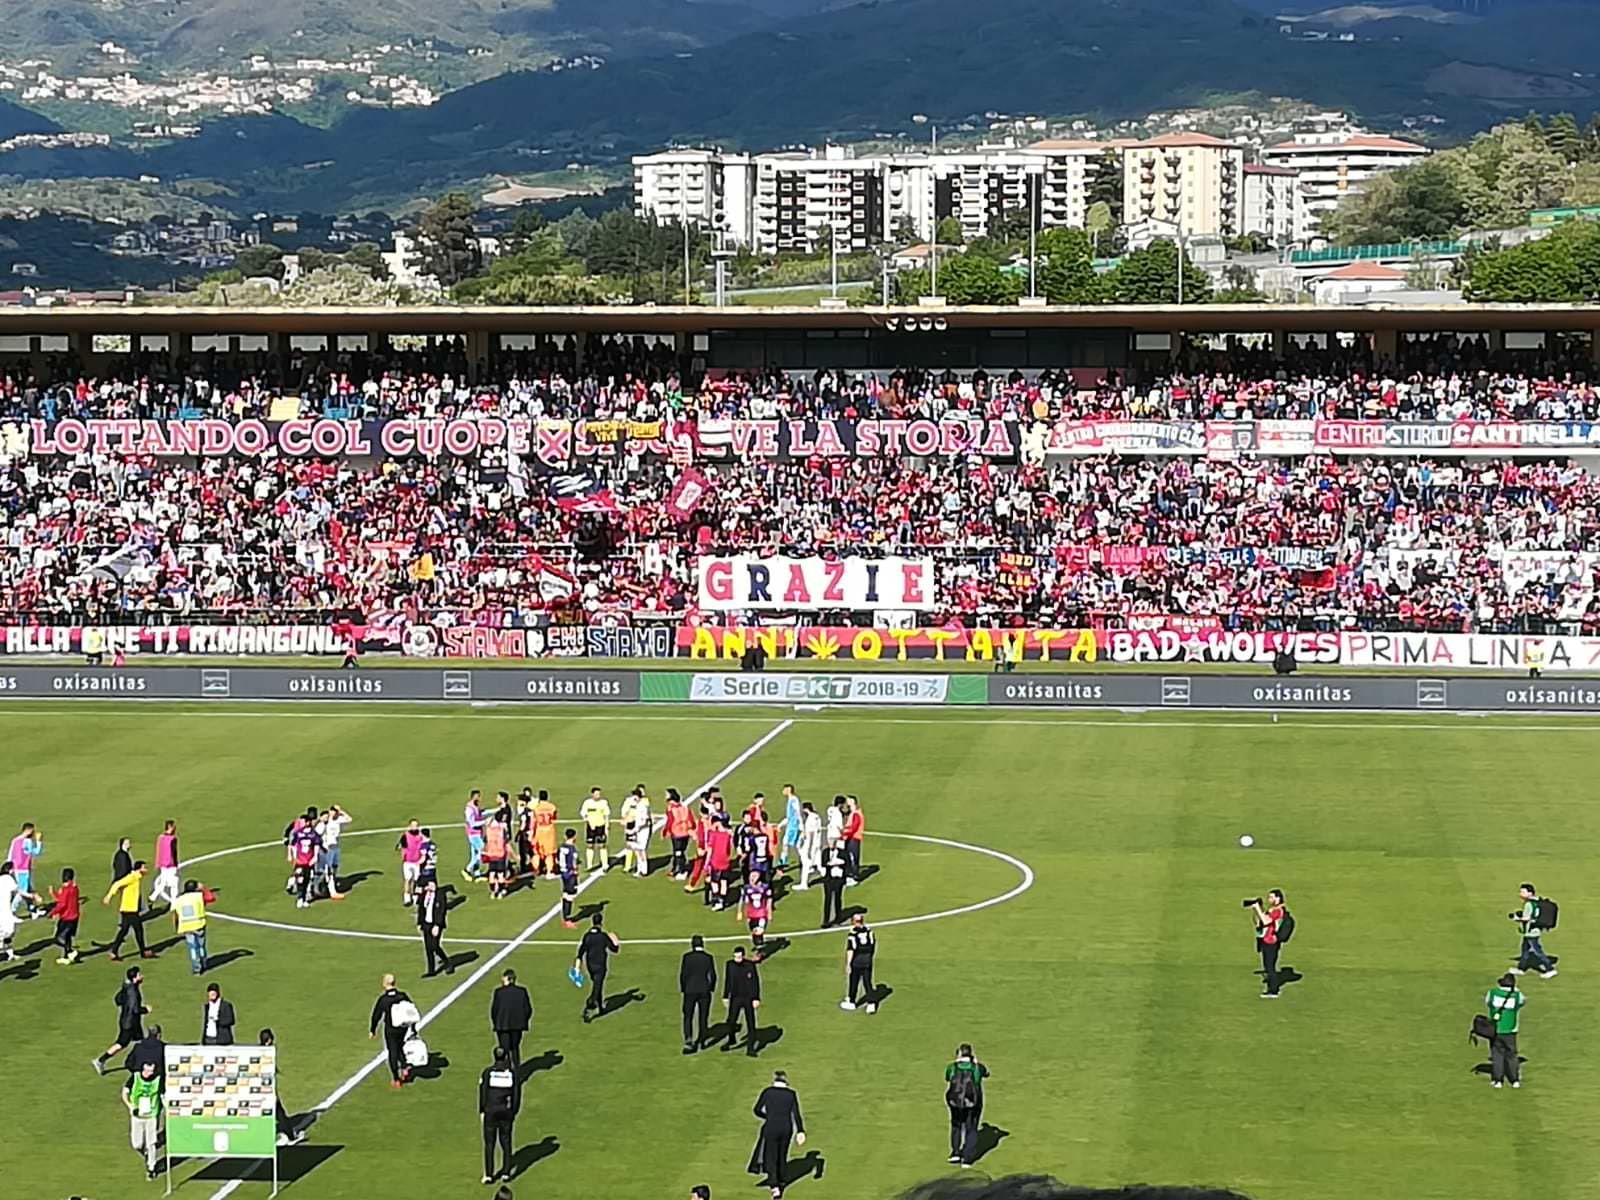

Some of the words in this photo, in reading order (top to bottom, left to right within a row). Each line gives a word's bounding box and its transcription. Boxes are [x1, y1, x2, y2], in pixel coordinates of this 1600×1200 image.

[30, 418, 269, 455] LOTTANDO
[279, 419, 371, 455] COL
[382, 418, 531, 455] CUORE
[789, 420, 850, 456] LA
[856, 419, 1015, 456] STORIA
[1317, 424, 1386, 444] CENTRO
[1453, 424, 1600, 444] CANTINELLA
[705, 561, 924, 603] GRAZIE
[6, 626, 70, 652] ALLA
[151, 626, 179, 653] TI
[189, 625, 343, 652] RIMANGONO
[691, 628, 795, 660] ANNI
[1112, 631, 1181, 662] BAD
[1208, 631, 1339, 662] WOLVES
[1348, 635, 1453, 664] PRIMA
[53, 673, 146, 690] oxisanitas
[289, 675, 382, 693] oxisanitas
[527, 677, 620, 694] oxisanitas
[723, 676, 779, 695] Serie
[786, 676, 852, 699] BKT
[857, 682, 919, 697] 2018-19
[1006, 680, 1102, 698] oxisanitas
[1254, 683, 1351, 701] oxisanitas
